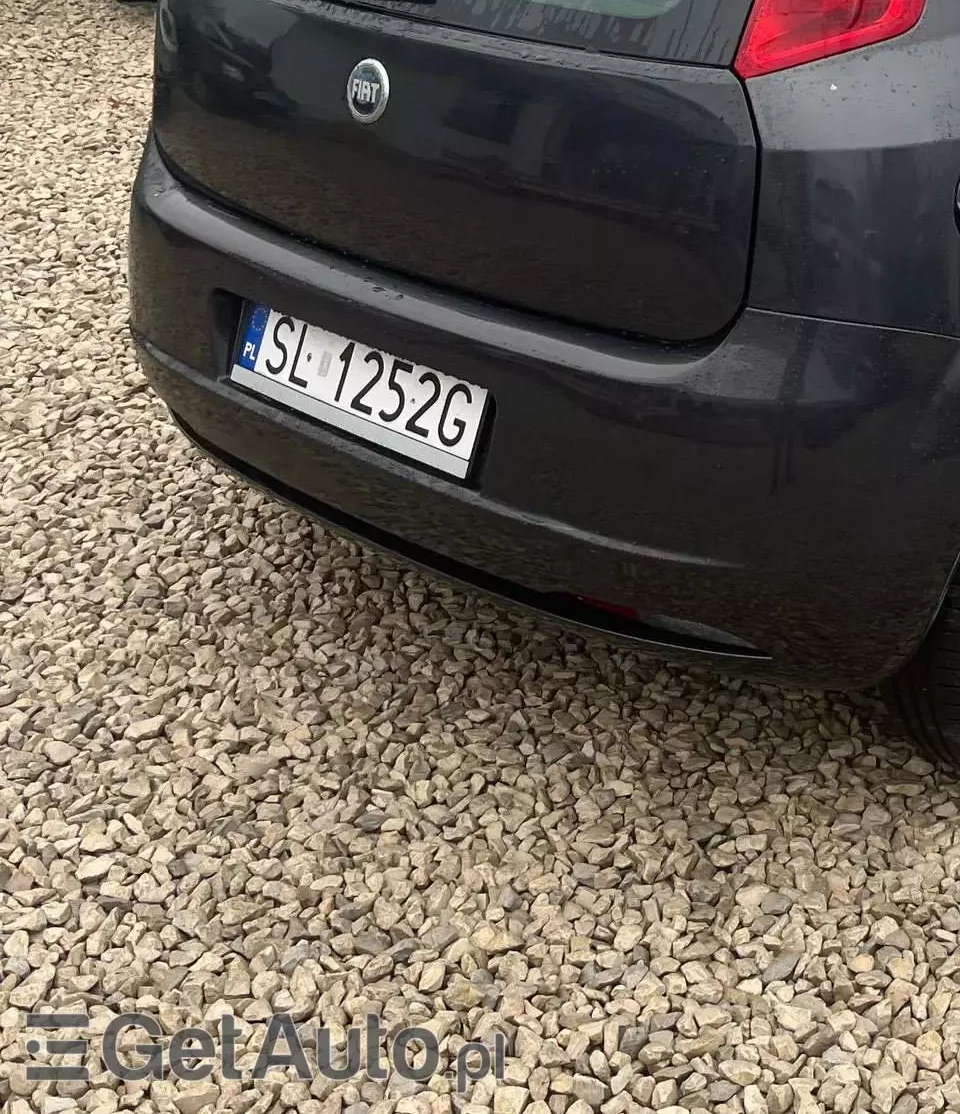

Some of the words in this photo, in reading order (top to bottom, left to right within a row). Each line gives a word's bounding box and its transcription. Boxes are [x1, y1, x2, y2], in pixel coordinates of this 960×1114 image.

[351, 78, 380, 103] FIAT
[242, 342, 256, 361] PL
[265, 316, 308, 388] SL
[334, 342, 473, 447] 1252G
